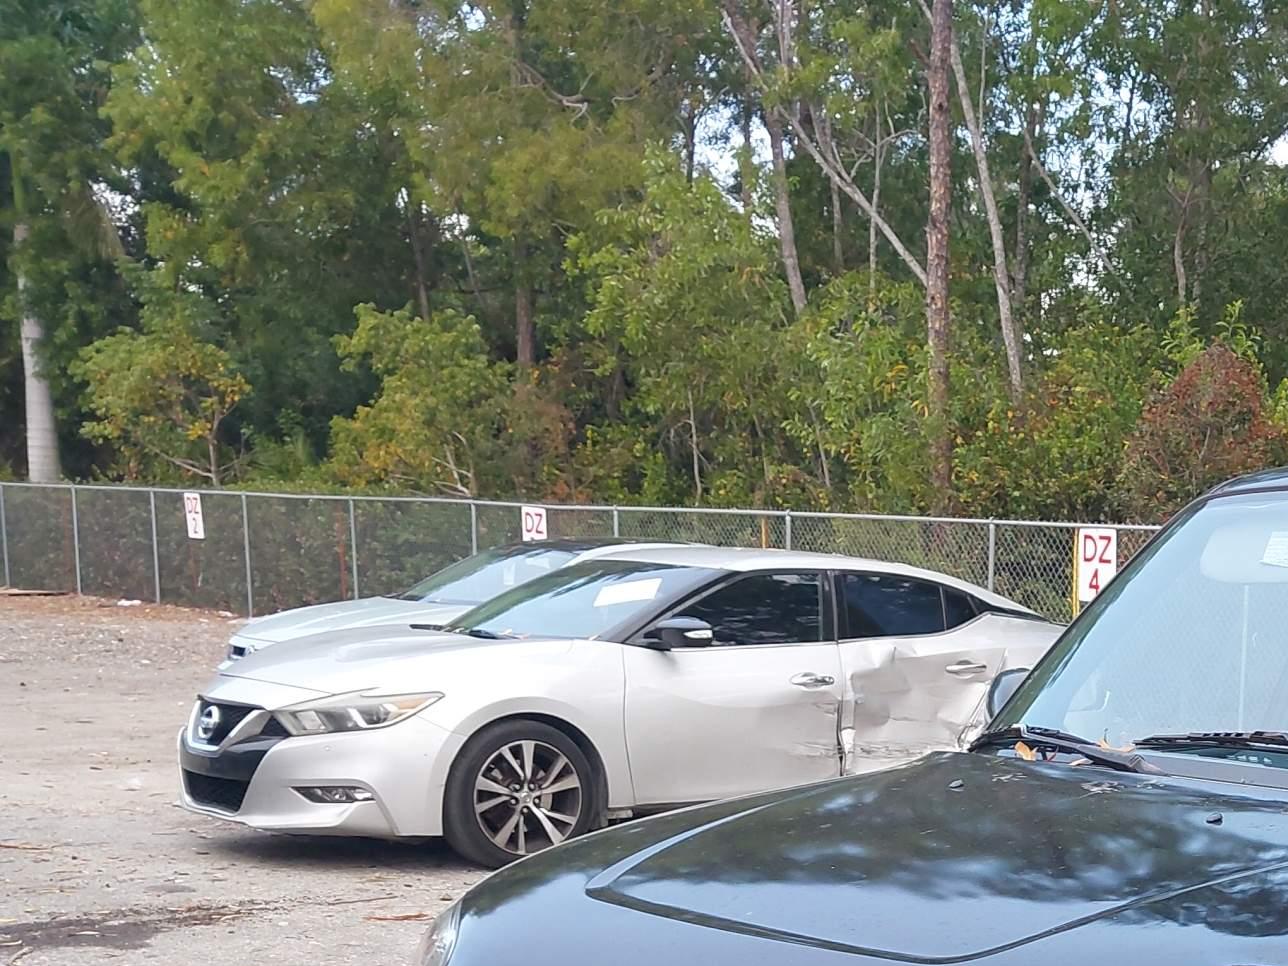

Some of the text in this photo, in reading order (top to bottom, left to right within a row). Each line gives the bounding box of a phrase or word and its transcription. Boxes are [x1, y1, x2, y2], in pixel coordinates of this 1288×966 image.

[525, 512, 544, 534] DZ
[1083, 534, 1112, 564] DZ
[1088, 568, 1100, 595] 4
